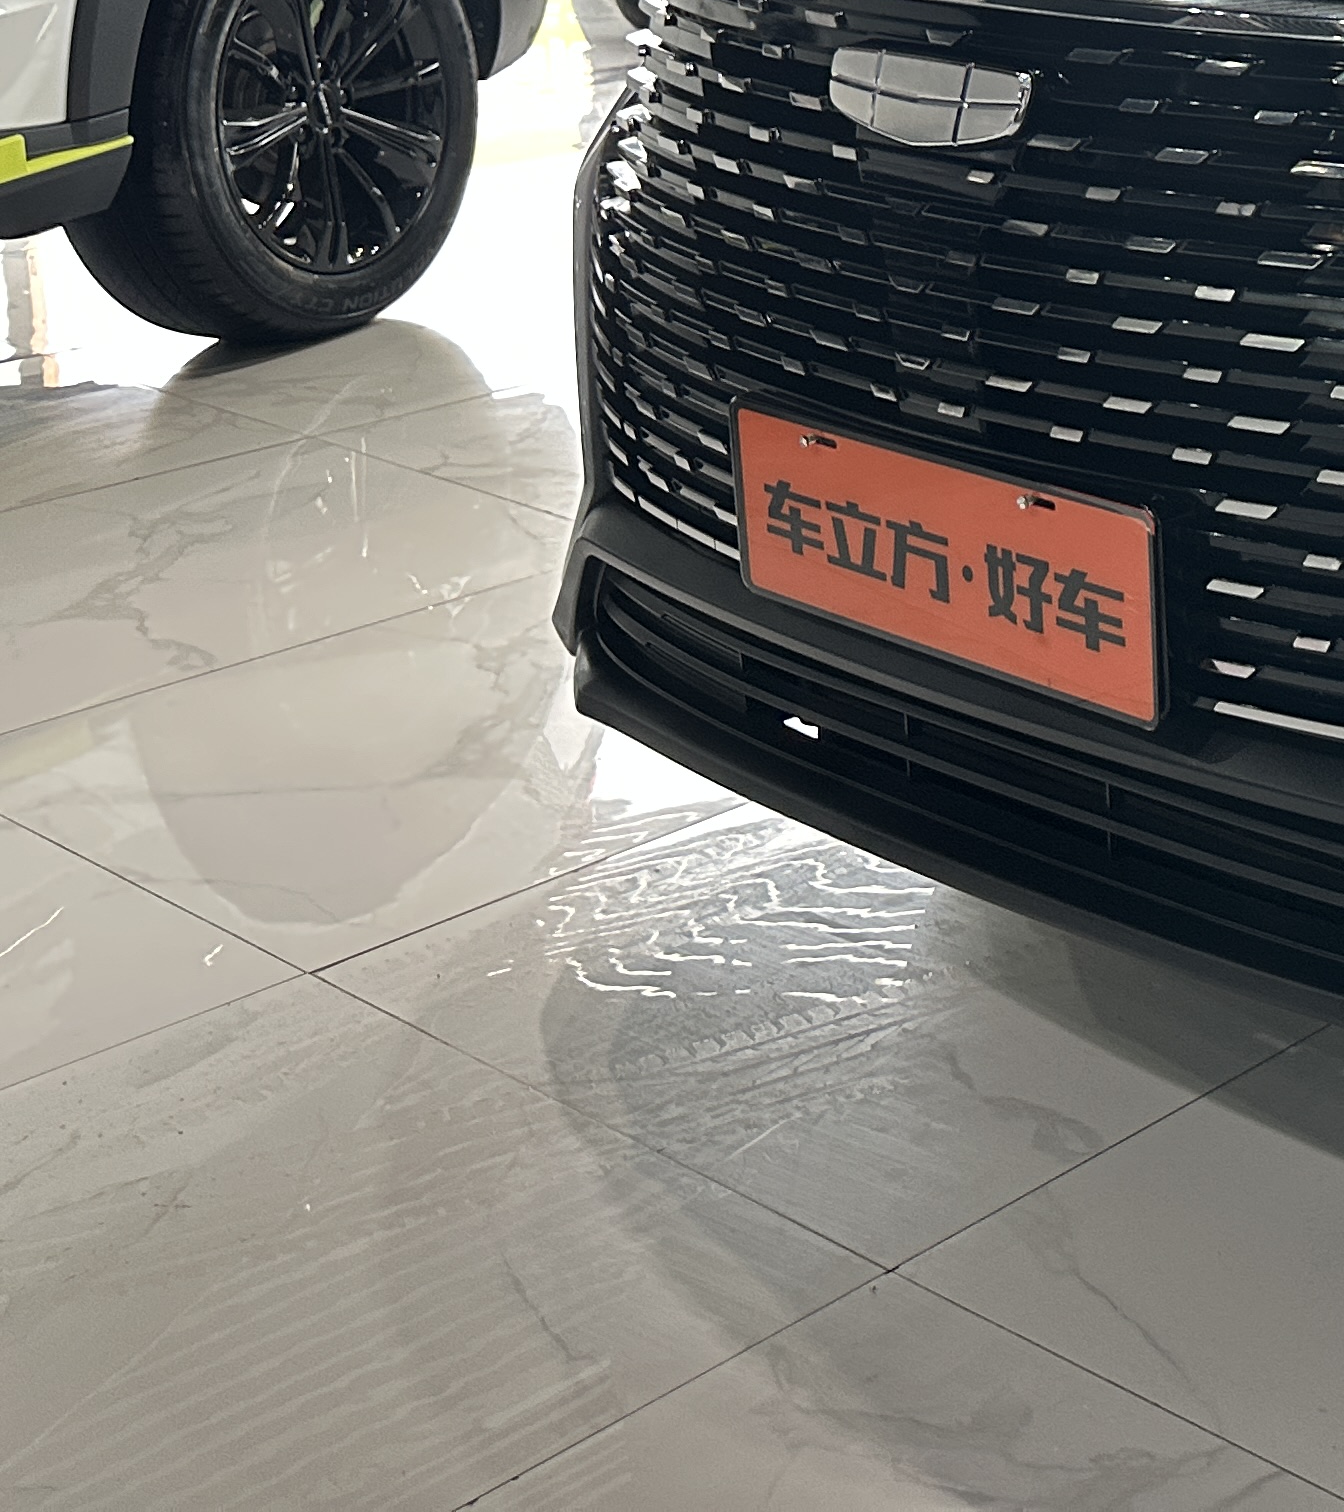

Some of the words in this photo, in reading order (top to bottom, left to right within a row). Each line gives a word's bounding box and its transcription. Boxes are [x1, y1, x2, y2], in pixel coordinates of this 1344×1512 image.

[763, 479, 1127, 653] 车立方·好车
